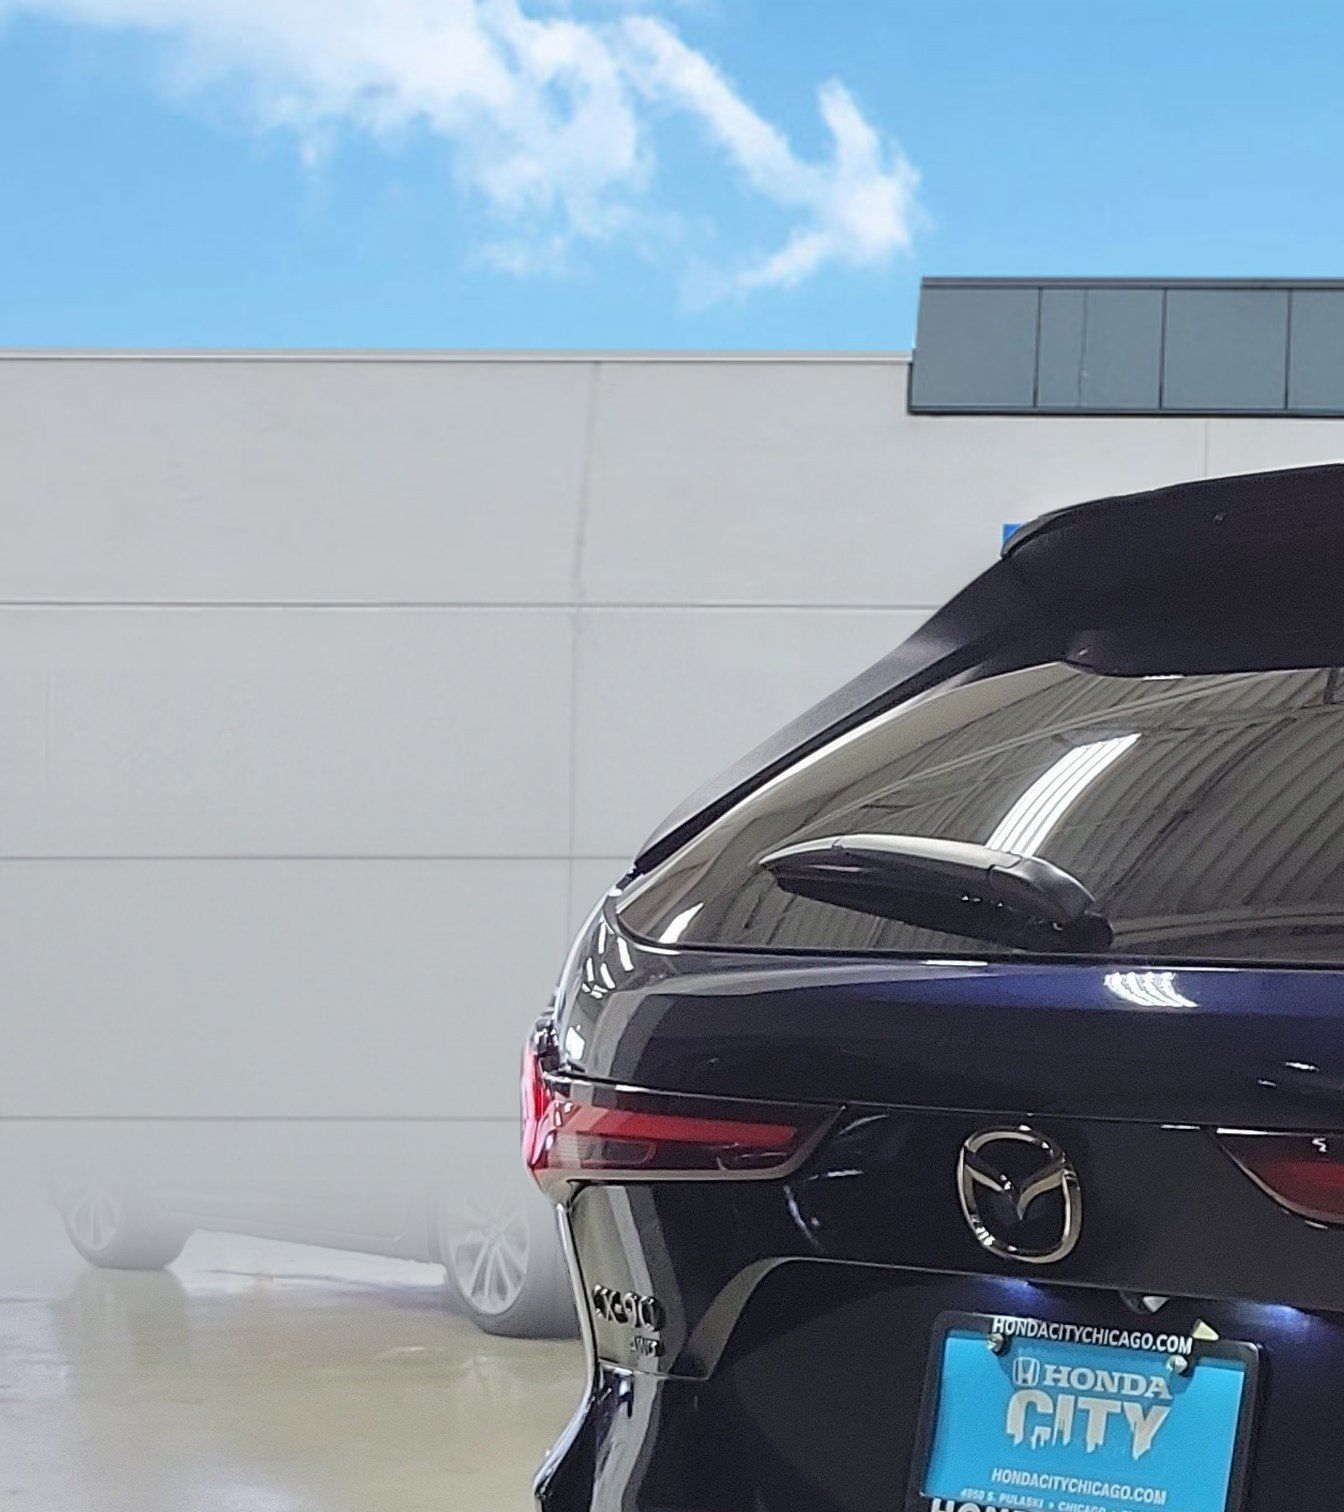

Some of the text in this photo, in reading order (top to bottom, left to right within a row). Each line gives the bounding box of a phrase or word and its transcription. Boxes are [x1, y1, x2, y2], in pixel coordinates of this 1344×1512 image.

[992, 1316, 1192, 1355] HONDACITYCHICAGO.COM
[1042, 1364, 1173, 1400] HONDA
[1006, 1389, 1171, 1461] CITY
[991, 1467, 1167, 1506] HONDACITYCHICAGO.COM
